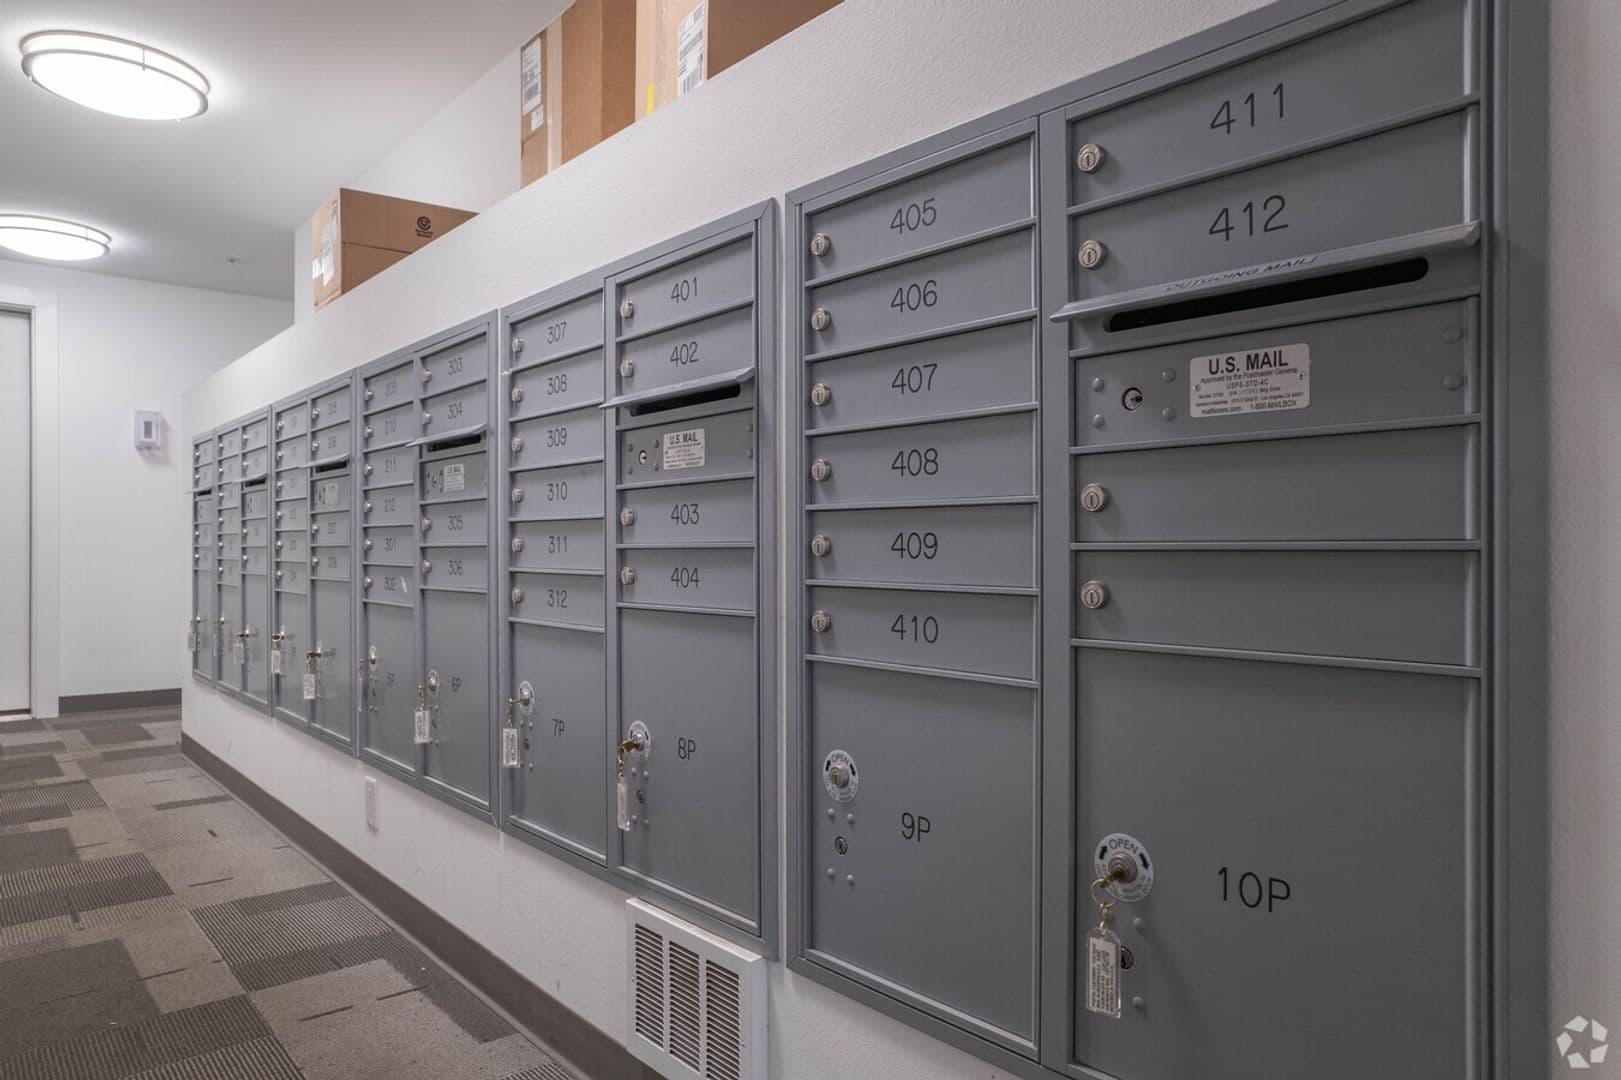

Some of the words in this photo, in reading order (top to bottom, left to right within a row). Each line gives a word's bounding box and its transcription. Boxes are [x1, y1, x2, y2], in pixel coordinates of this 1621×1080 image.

[1210, 82, 1286, 135] 411
[890, 198, 937, 235] 405
[1208, 194, 1289, 242] 412
[670, 277, 698, 302] 401
[890, 280, 938, 313] 406
[547, 322, 567, 344] 307
[670, 341, 699, 366] 402
[1208, 356, 1240, 375] U.S.
[1246, 350, 1289, 371] MAIL
[448, 357, 463, 376] 303
[1200, 376, 1225, 384] Approved
[1243, 370, 1273, 378] Postmaster
[1274, 367, 1298, 375] General
[547, 374, 568, 396] 308
[891, 363, 938, 395] 407
[447, 402, 463, 421] 304
[1250, 400, 1297, 411] 1-800-MAILBOX
[547, 428, 568, 448] 309
[683, 431, 699, 443] MAIL
[384, 458, 397, 473] 211
[891, 448, 939, 477] 408
[547, 482, 568, 501] 310
[448, 515, 463, 531] 305
[671, 504, 700, 525] 403
[384, 537, 397, 552] 301
[549, 536, 568, 554] 311
[891, 532, 938, 559] 409
[448, 560, 463, 576] 306
[671, 567, 700, 588] 404
[384, 577, 397, 592] 302
[547, 590, 568, 608] 312
[891, 614, 939, 644] 410
[552, 718, 565, 737] 7P
[677, 737, 696, 761] 8P
[831, 753, 850, 765] OPEN
[901, 812, 931, 843] 9P
[1108, 837, 1139, 855] OPEN
[1217, 866, 1291, 912] 10P
